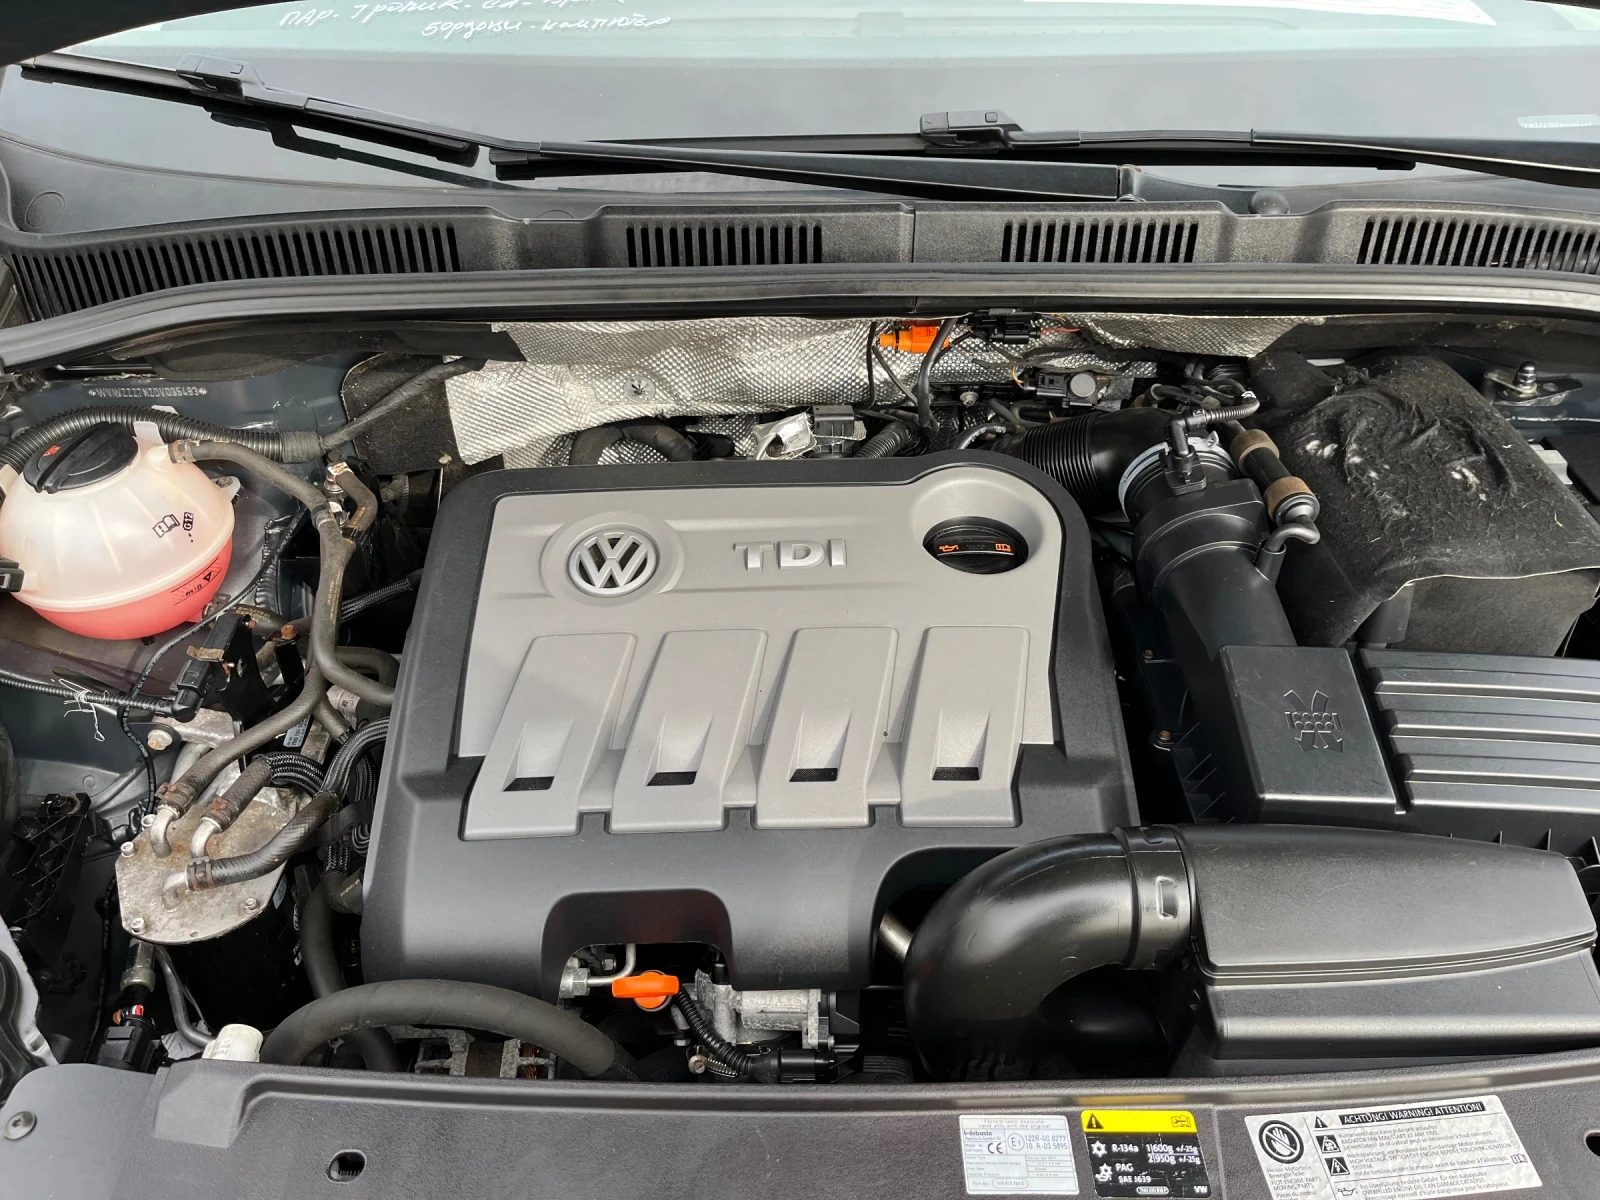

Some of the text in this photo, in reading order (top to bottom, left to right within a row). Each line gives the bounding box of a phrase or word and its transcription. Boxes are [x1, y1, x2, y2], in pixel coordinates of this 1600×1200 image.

[733, 538, 848, 572] TDI
[1344, 1103, 1482, 1124] ACHTUNG! WARNING! ATTENTION!
[1112, 1144, 1139, 1152] R-134a
[1115, 1163, 1134, 1172] PAG
